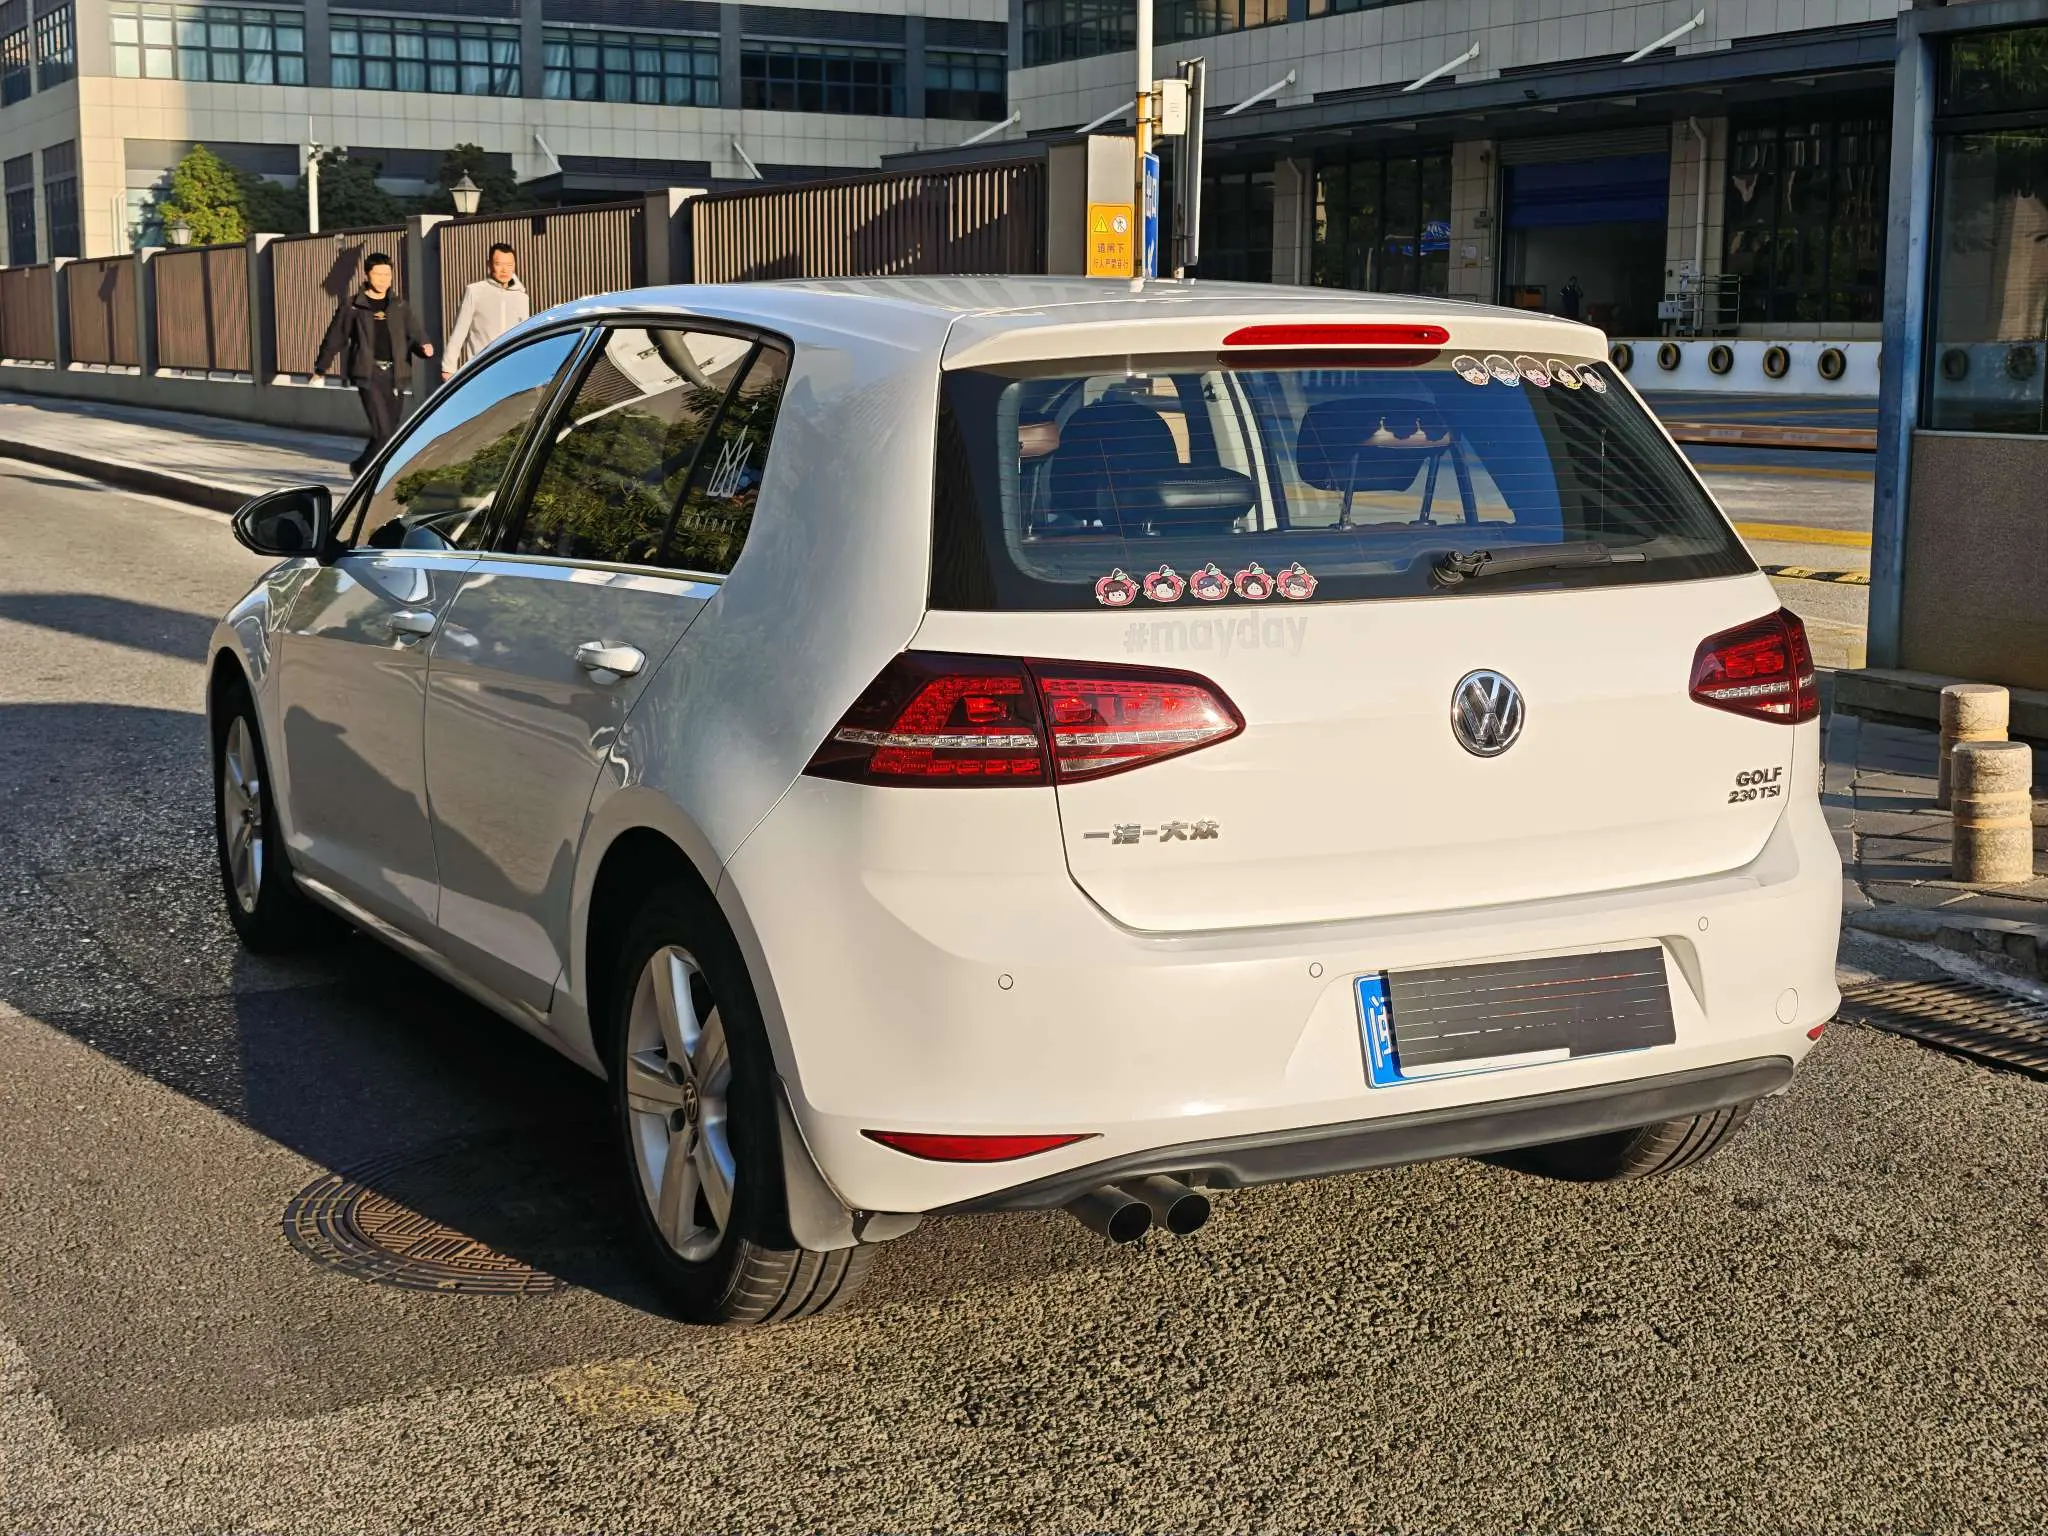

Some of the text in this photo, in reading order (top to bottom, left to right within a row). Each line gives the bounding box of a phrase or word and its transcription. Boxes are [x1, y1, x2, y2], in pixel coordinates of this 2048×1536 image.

[1123, 610, 1308, 659] #mayday
[1736, 766, 1782, 787] GOLF
[1728, 784, 1781, 804] 230 TSI
